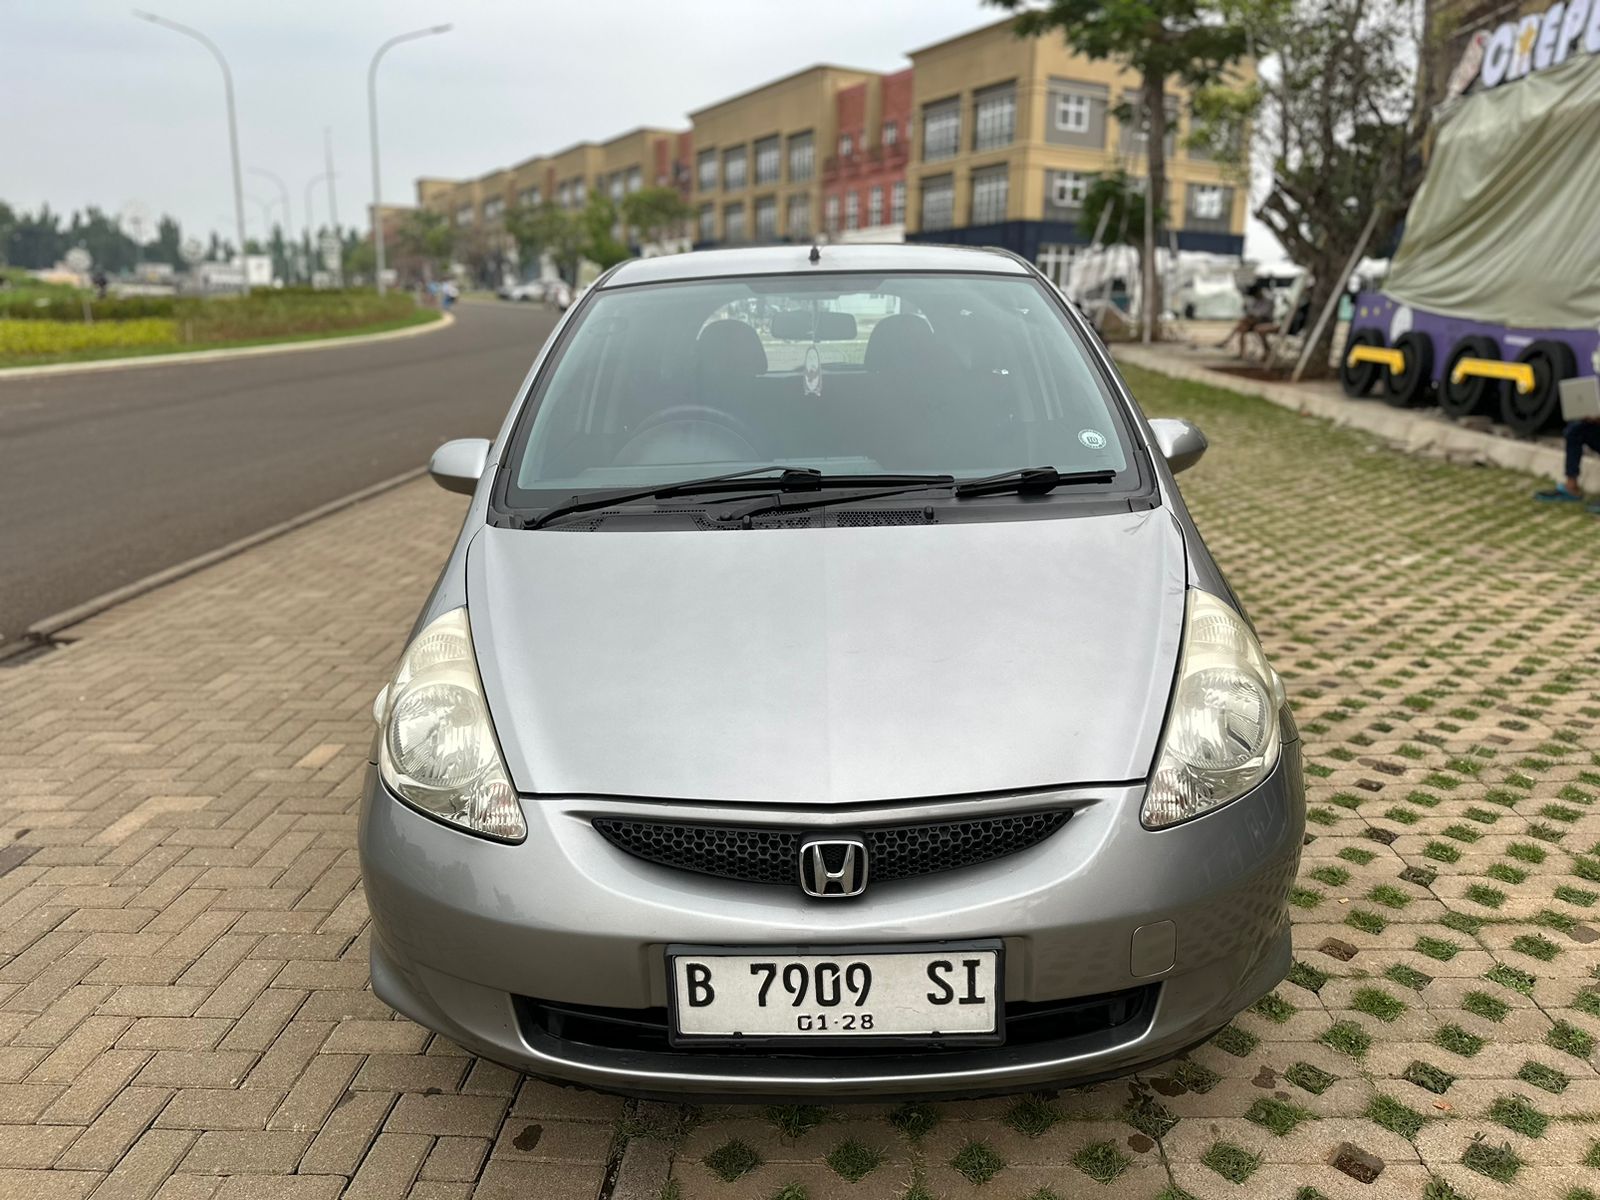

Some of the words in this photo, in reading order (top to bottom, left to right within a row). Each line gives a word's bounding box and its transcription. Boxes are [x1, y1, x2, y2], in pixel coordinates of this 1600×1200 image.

[686, 963, 715, 1007] B
[750, 963, 872, 1007] 7909
[926, 959, 986, 1006] SI
